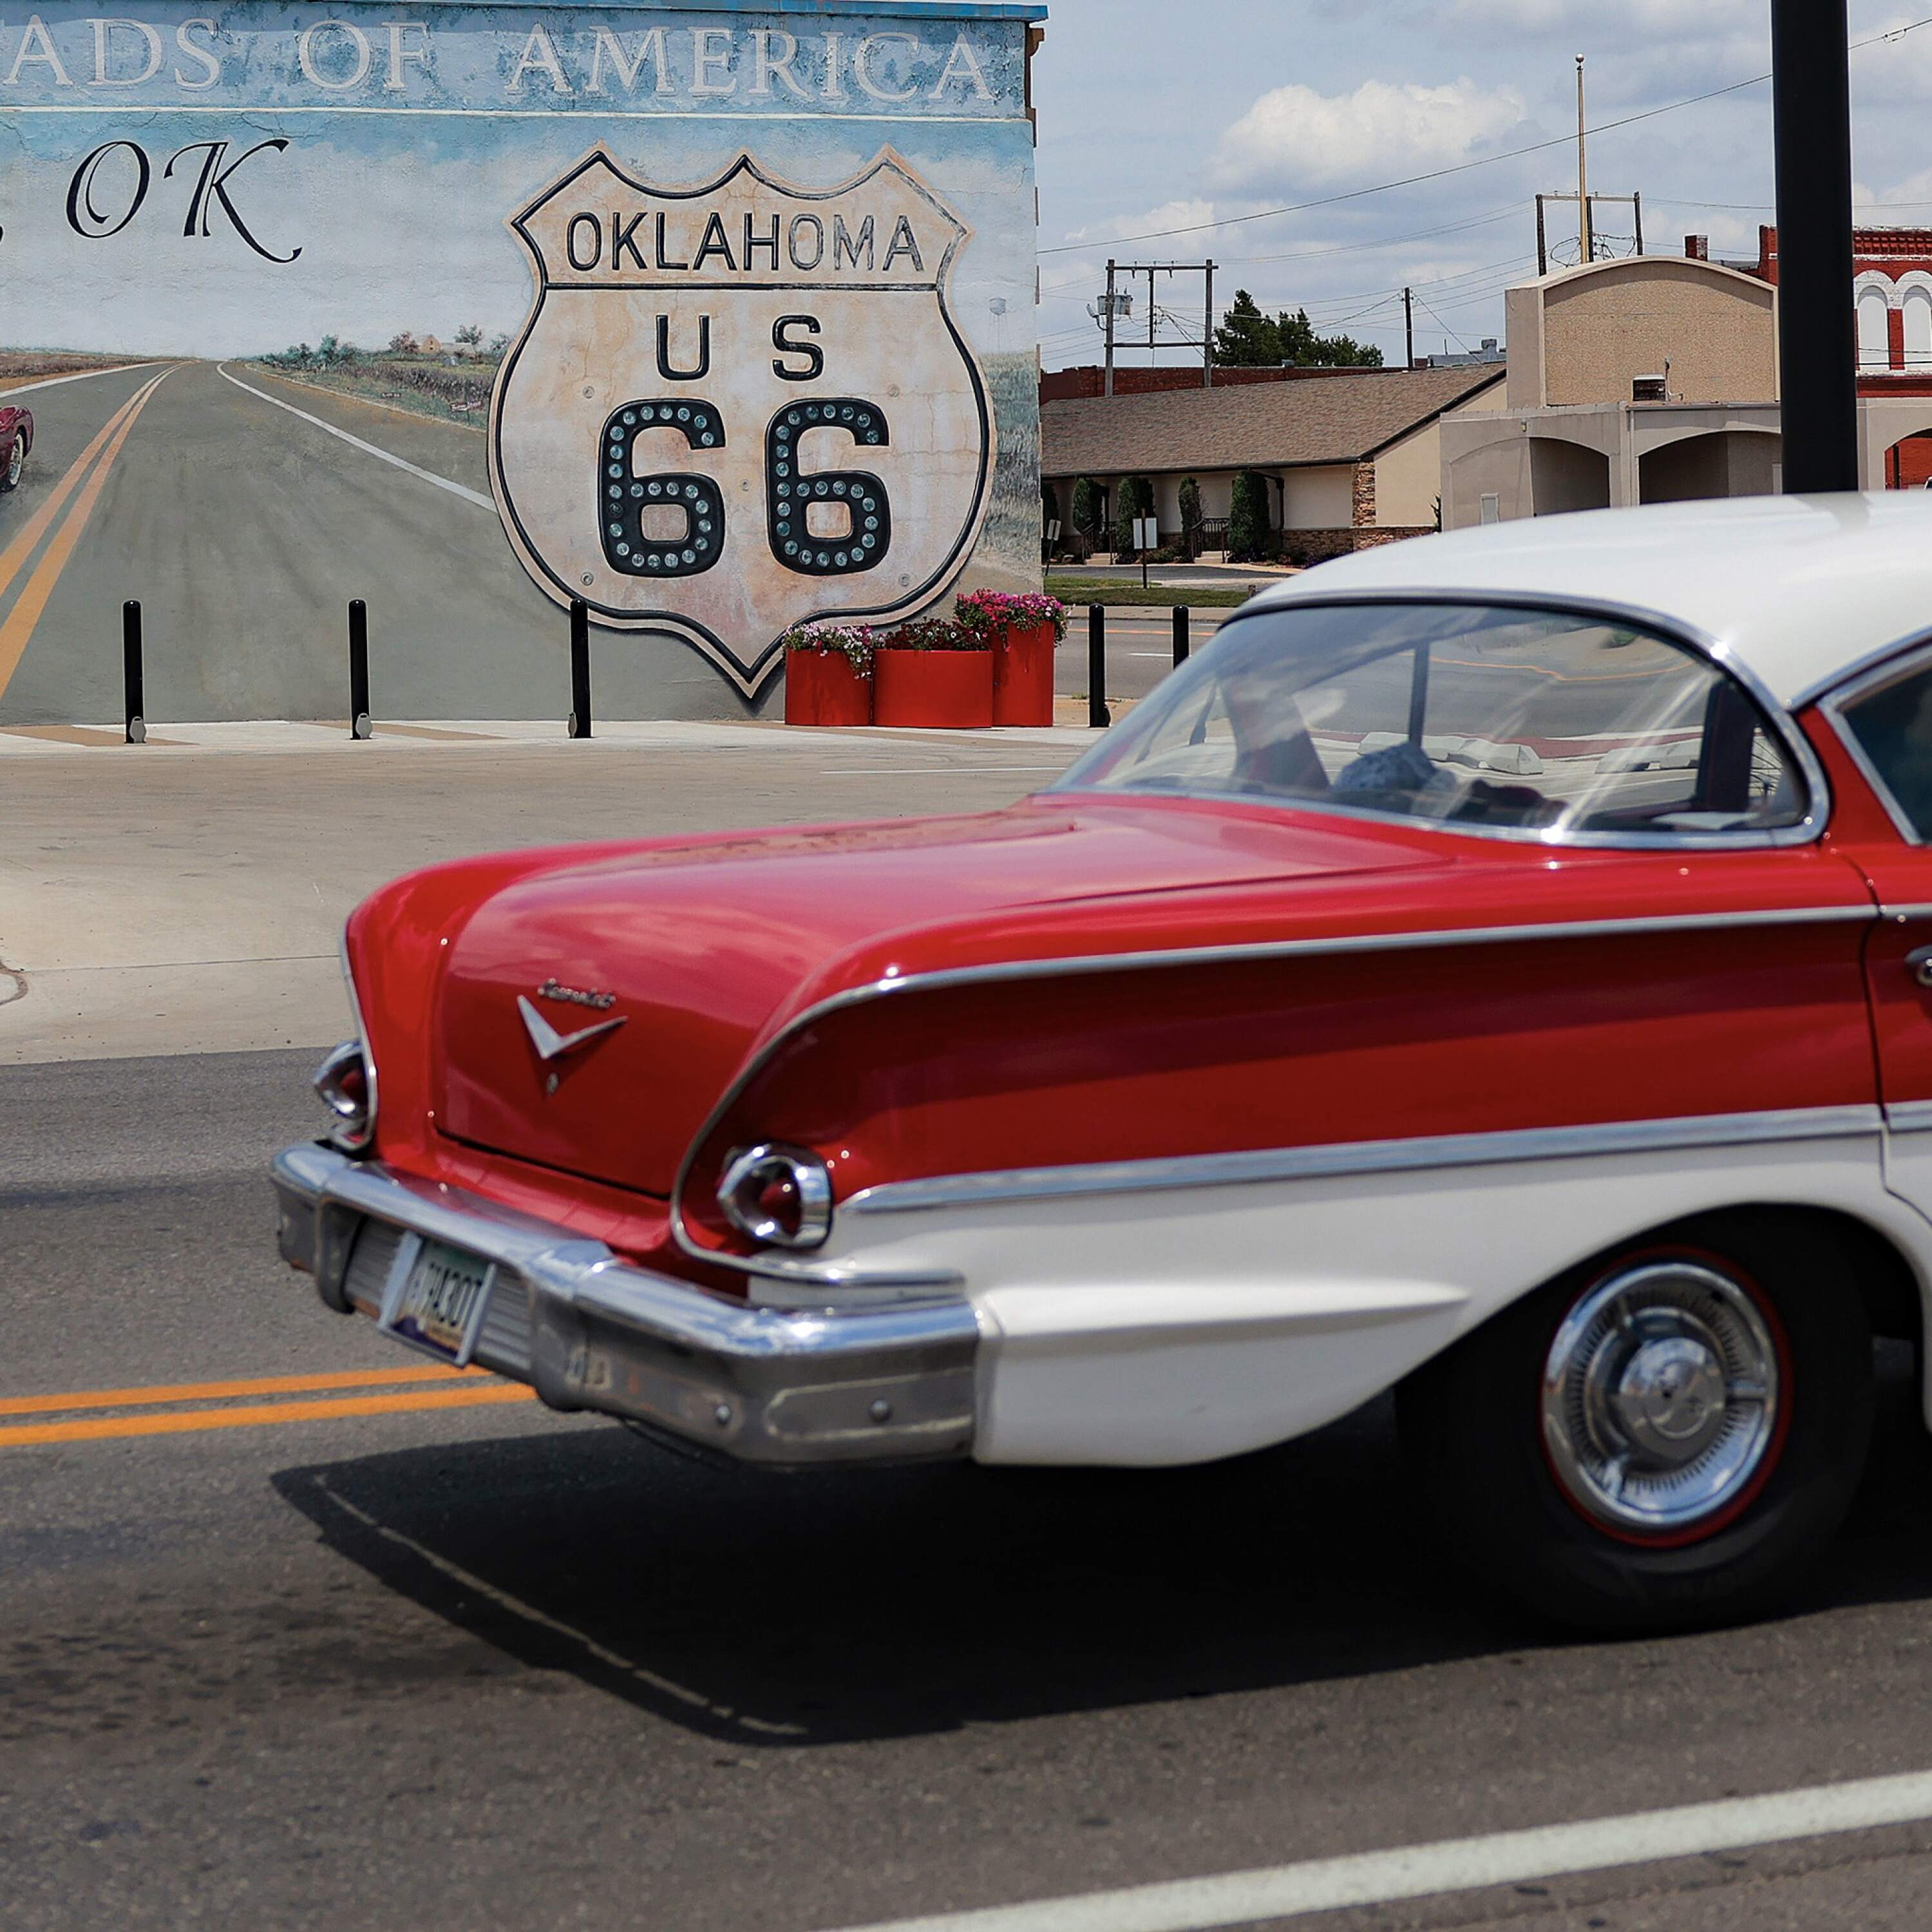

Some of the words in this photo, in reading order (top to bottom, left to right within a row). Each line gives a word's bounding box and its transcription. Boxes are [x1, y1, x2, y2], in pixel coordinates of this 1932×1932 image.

[2, 14, 222, 88] ADS
[298, 19, 433, 91] OF
[504, 22, 995, 102] AMERICA
[65, 139, 302, 264] OK
[566, 211, 924, 272] OKLAHOMA
[598, 397, 891, 578] 66
